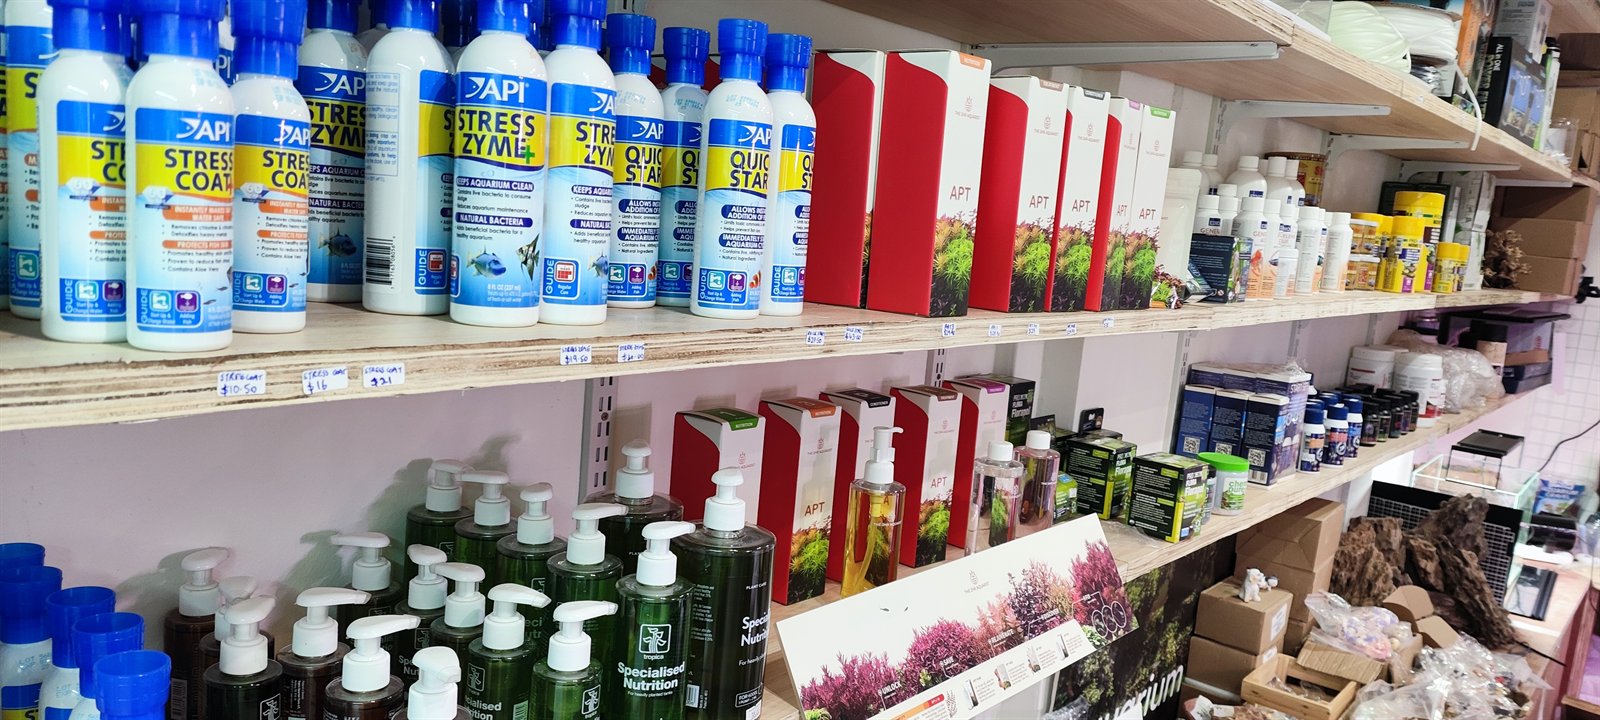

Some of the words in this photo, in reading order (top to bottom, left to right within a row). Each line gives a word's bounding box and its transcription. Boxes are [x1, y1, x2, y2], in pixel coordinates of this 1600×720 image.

[479, 77, 525, 104] API
[459, 109, 535, 137] STRESS
[194, 119, 230, 142] API
[165, 149, 234, 172] STRESS
[322, 166, 359, 177] AQUARIUM
[470, 179, 511, 190] AQUARIUM
[511, 183, 533, 191] CLEAN
[573, 186, 592, 195] KEEPS
[949, 185, 971, 202] APT
[309, 198, 340, 208] NATURAL
[1029, 195, 1049, 209] APT
[1072, 199, 1091, 213] APT
[727, 212, 757, 220] ADDITION
[731, 206, 756, 214] ALLOWS
[1117, 204, 1128, 217] APT
[1139, 208, 1156, 221] APT
[460, 213, 488, 224] NATURAL
[489, 216, 524, 226] BACTERIA
[581, 219, 605, 228] NATURAL
[621, 227, 656, 235] IMMEDIATELY
[722, 233, 760, 242] IMMEDIATELY
[177, 240, 208, 248] PROTECTS
[725, 240, 758, 249] AQUARIUM
[418, 250, 427, 285] GUIDE
[545, 259, 554, 294] GUIDE
[773, 266, 781, 294] GUIDE
[233, 272, 241, 303] GUIDE
[699, 269, 707, 300] GUIDE
[64, 279, 73, 314] GUIDE
[140, 289, 148, 323] GUIDE
[303, 370, 329, 381] STRESS
[370, 376, 392, 387] $21
[306, 382, 328, 395] $16
[930, 476, 947, 489] APT
[804, 501, 826, 516] APT
[617, 661, 685, 679] Specialised
[624, 676, 679, 692] Nutrition
[881, 680, 901, 695] UNLOCK
